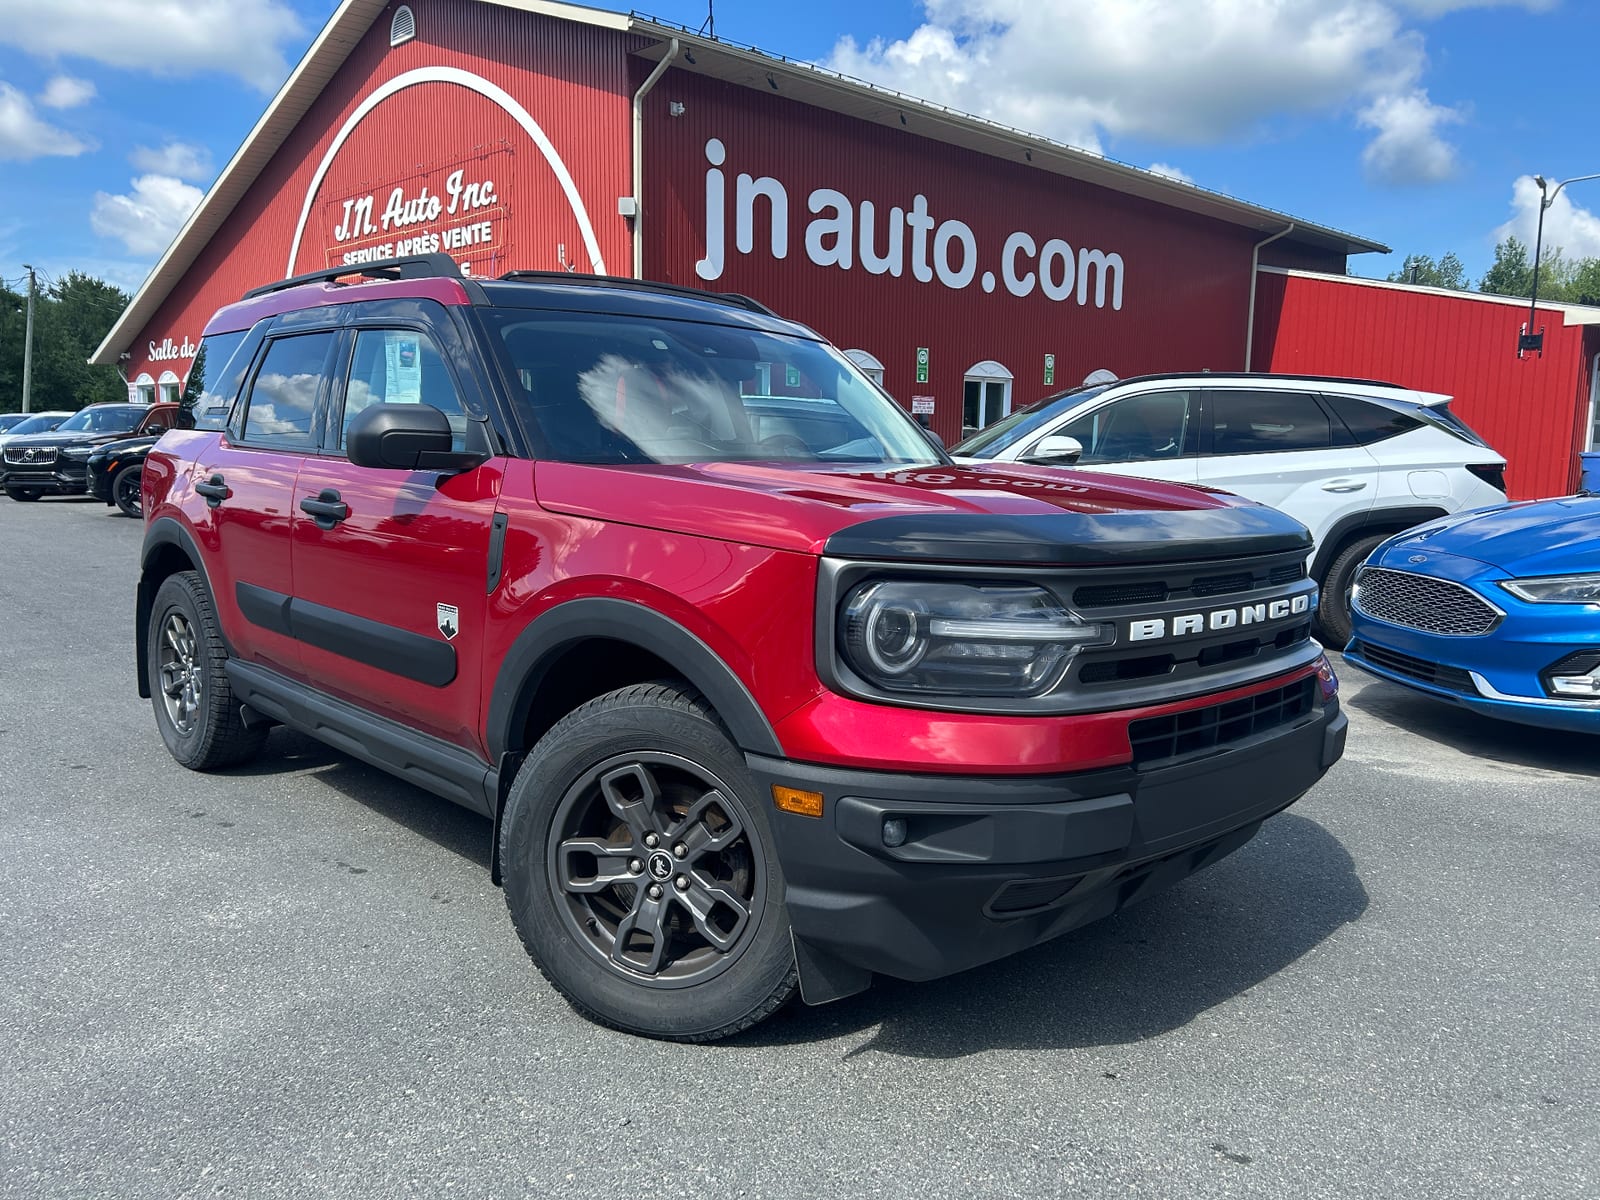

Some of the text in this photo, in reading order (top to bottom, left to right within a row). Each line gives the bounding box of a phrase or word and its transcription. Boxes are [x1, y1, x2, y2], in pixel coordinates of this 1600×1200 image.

[335, 169, 498, 242] J.N. Auto Inc.
[343, 221, 492, 267] SERVICE APRÈS VENTE
[148, 335, 197, 362] Salle de
[1129, 594, 1310, 642] BRONCO
